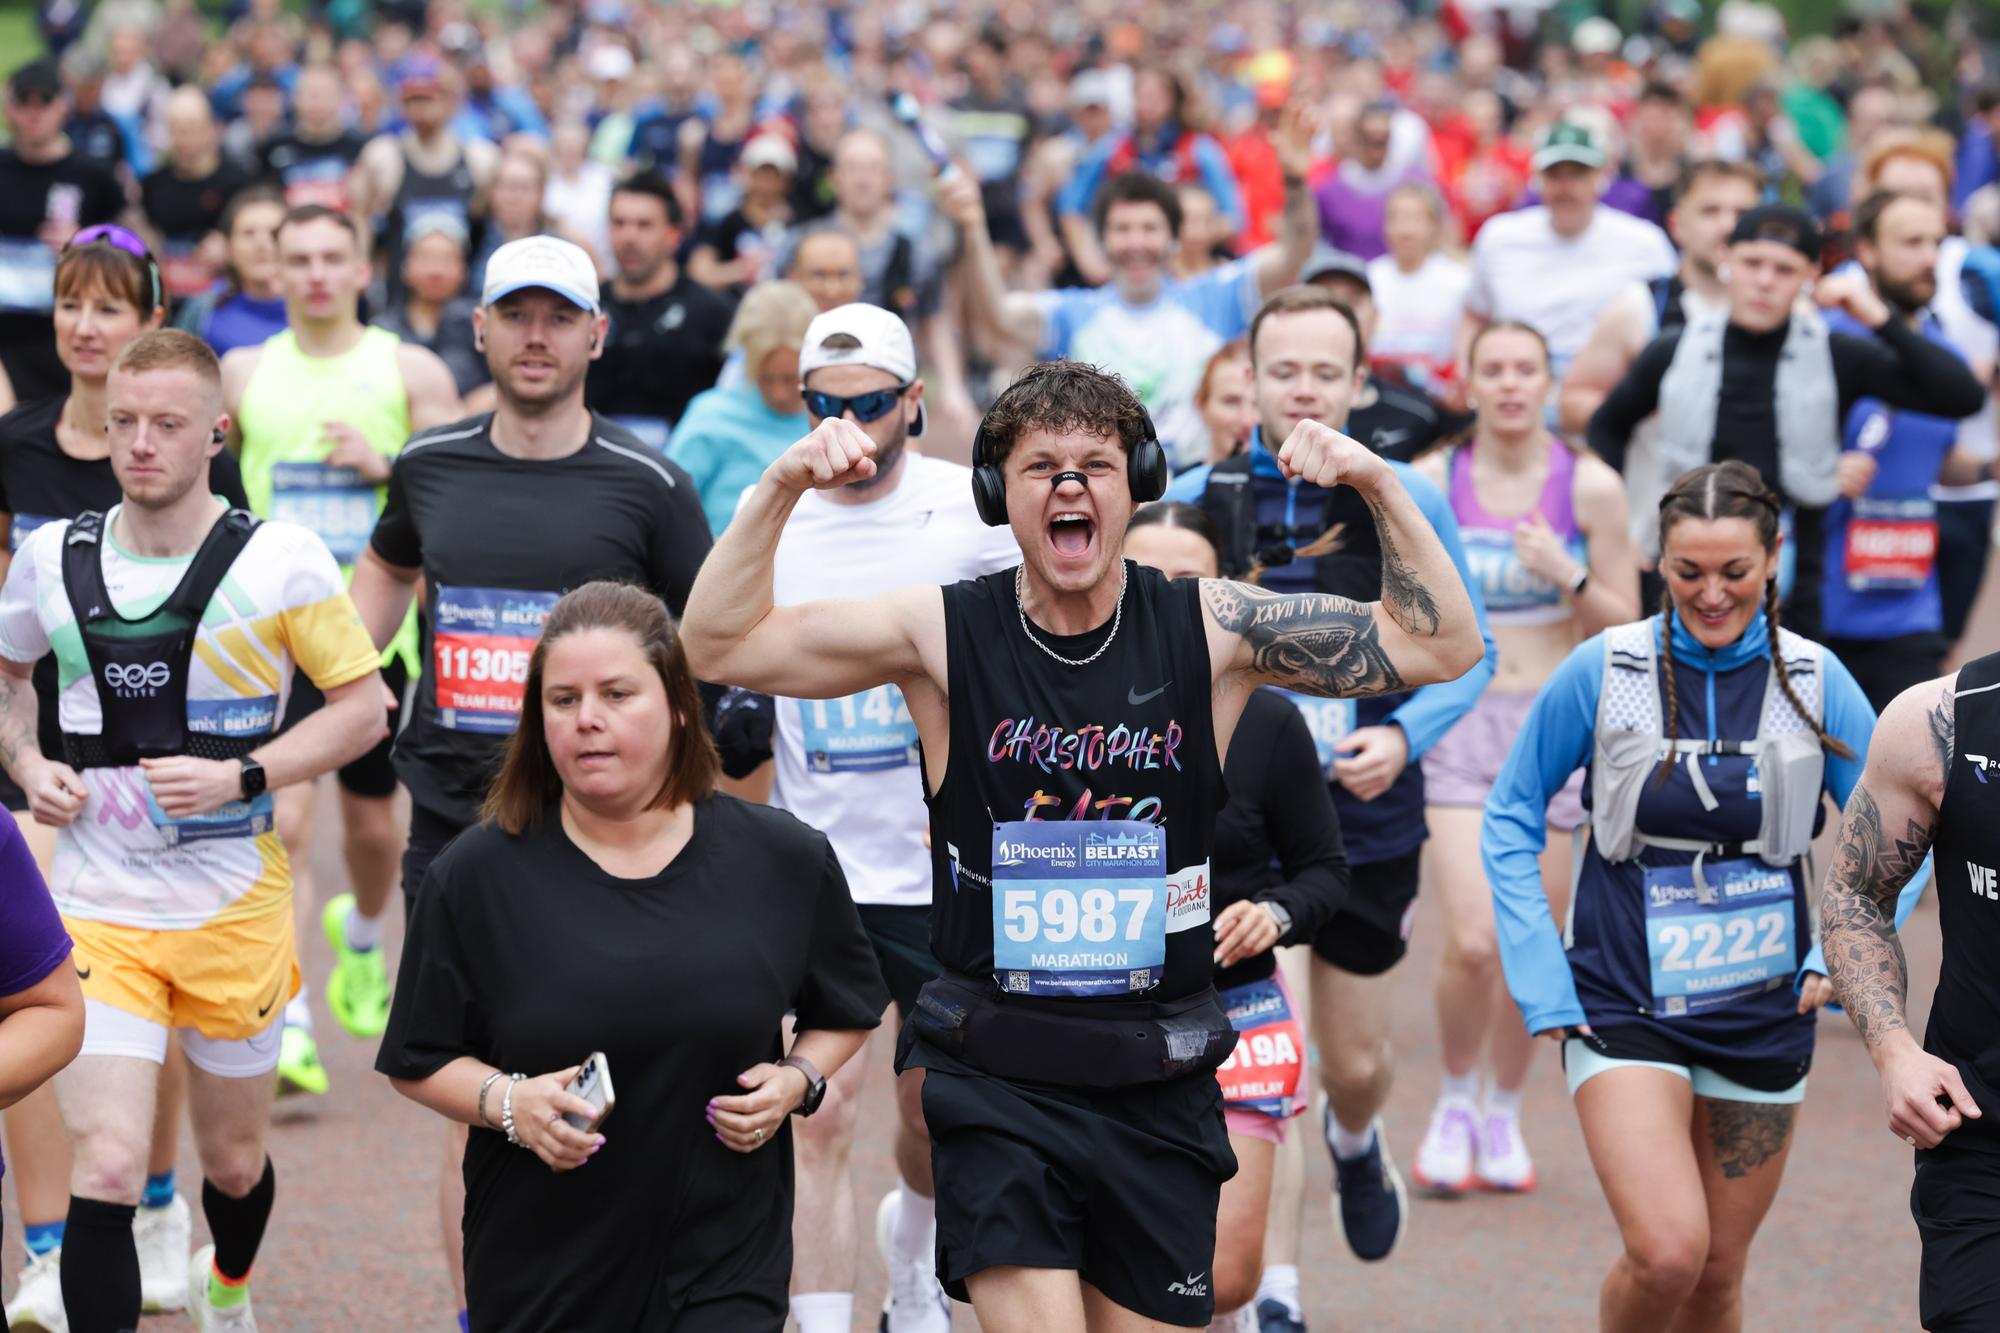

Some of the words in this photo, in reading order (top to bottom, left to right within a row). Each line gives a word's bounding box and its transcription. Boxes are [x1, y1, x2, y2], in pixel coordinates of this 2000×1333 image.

[1299, 597, 1316, 618] IV
[116, 688, 157, 698] ELITE
[453, 692, 485, 708] TEAM
[827, 733, 906, 751] MARATHON
[987, 715, 1183, 774] CHRISTOPHER
[1011, 843, 1076, 858] Phoenix
[1086, 845, 1159, 859] BELFAST
[1051, 860, 1076, 868] Energy
[1086, 859, 1101, 867] CITY
[1103, 859, 1142, 867] MARATHON
[1143, 859, 1160, 867] 2026
[1662, 886, 1718, 900] Phoex
[1724, 874, 1786, 897] BELFAST
[1967, 861, 1999, 900] WE
[1004, 889, 1154, 943] 5987
[1173, 902, 1207, 917] FOODBANK
[1658, 912, 1788, 972] 2222
[1031, 953, 1128, 967] MARATHON
[1034, 978, 1126, 987] www.belfastcitymarathon.com
[1685, 966, 1768, 991] MARATHON
[1240, 1081, 1285, 1098] RELAY
